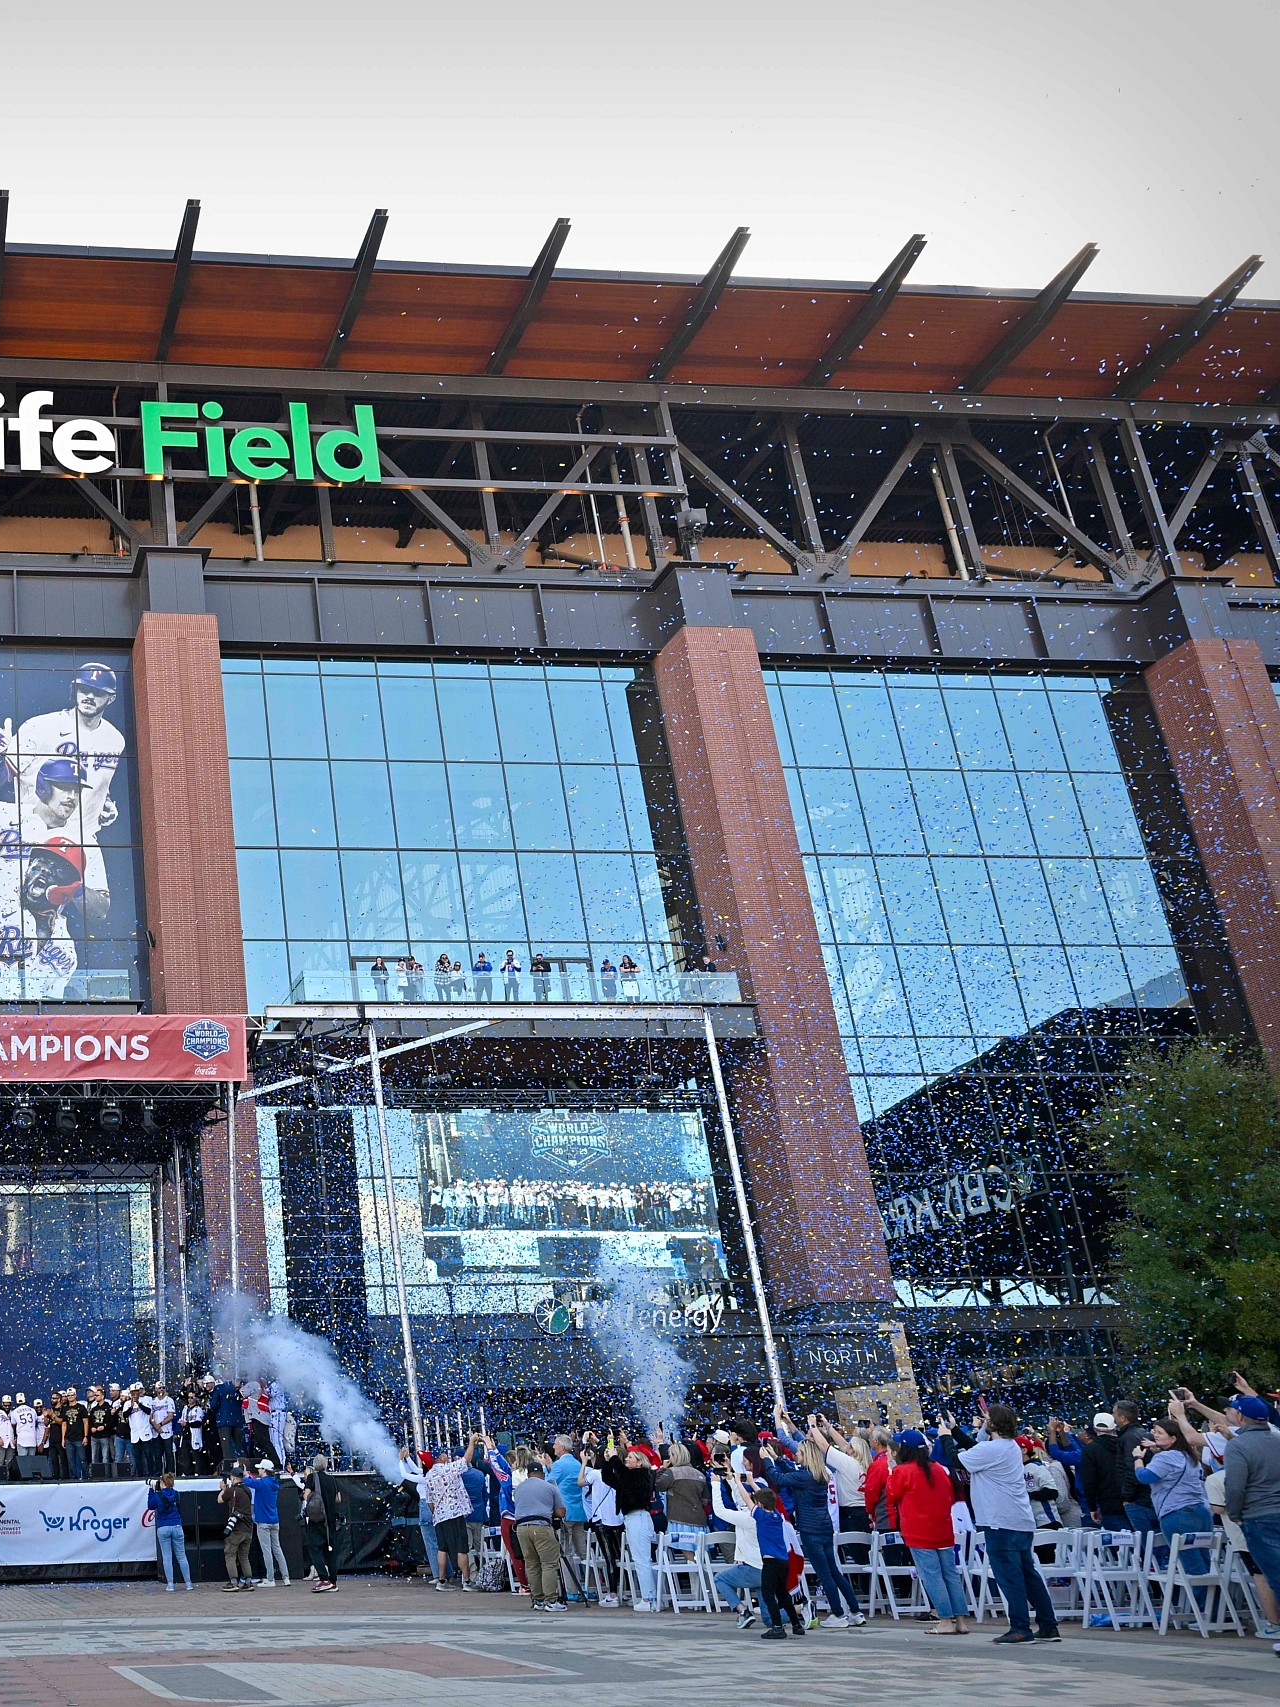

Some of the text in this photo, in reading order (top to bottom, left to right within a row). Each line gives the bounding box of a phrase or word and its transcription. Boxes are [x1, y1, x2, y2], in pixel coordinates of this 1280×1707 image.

[140, 401, 382, 483] Field
[534, 1135, 606, 1148] CHAMPIONS
[809, 1349, 878, 1364] NORTH
[19, 1413, 34, 1425] 53
[70, 1506, 130, 1542] Kroger
